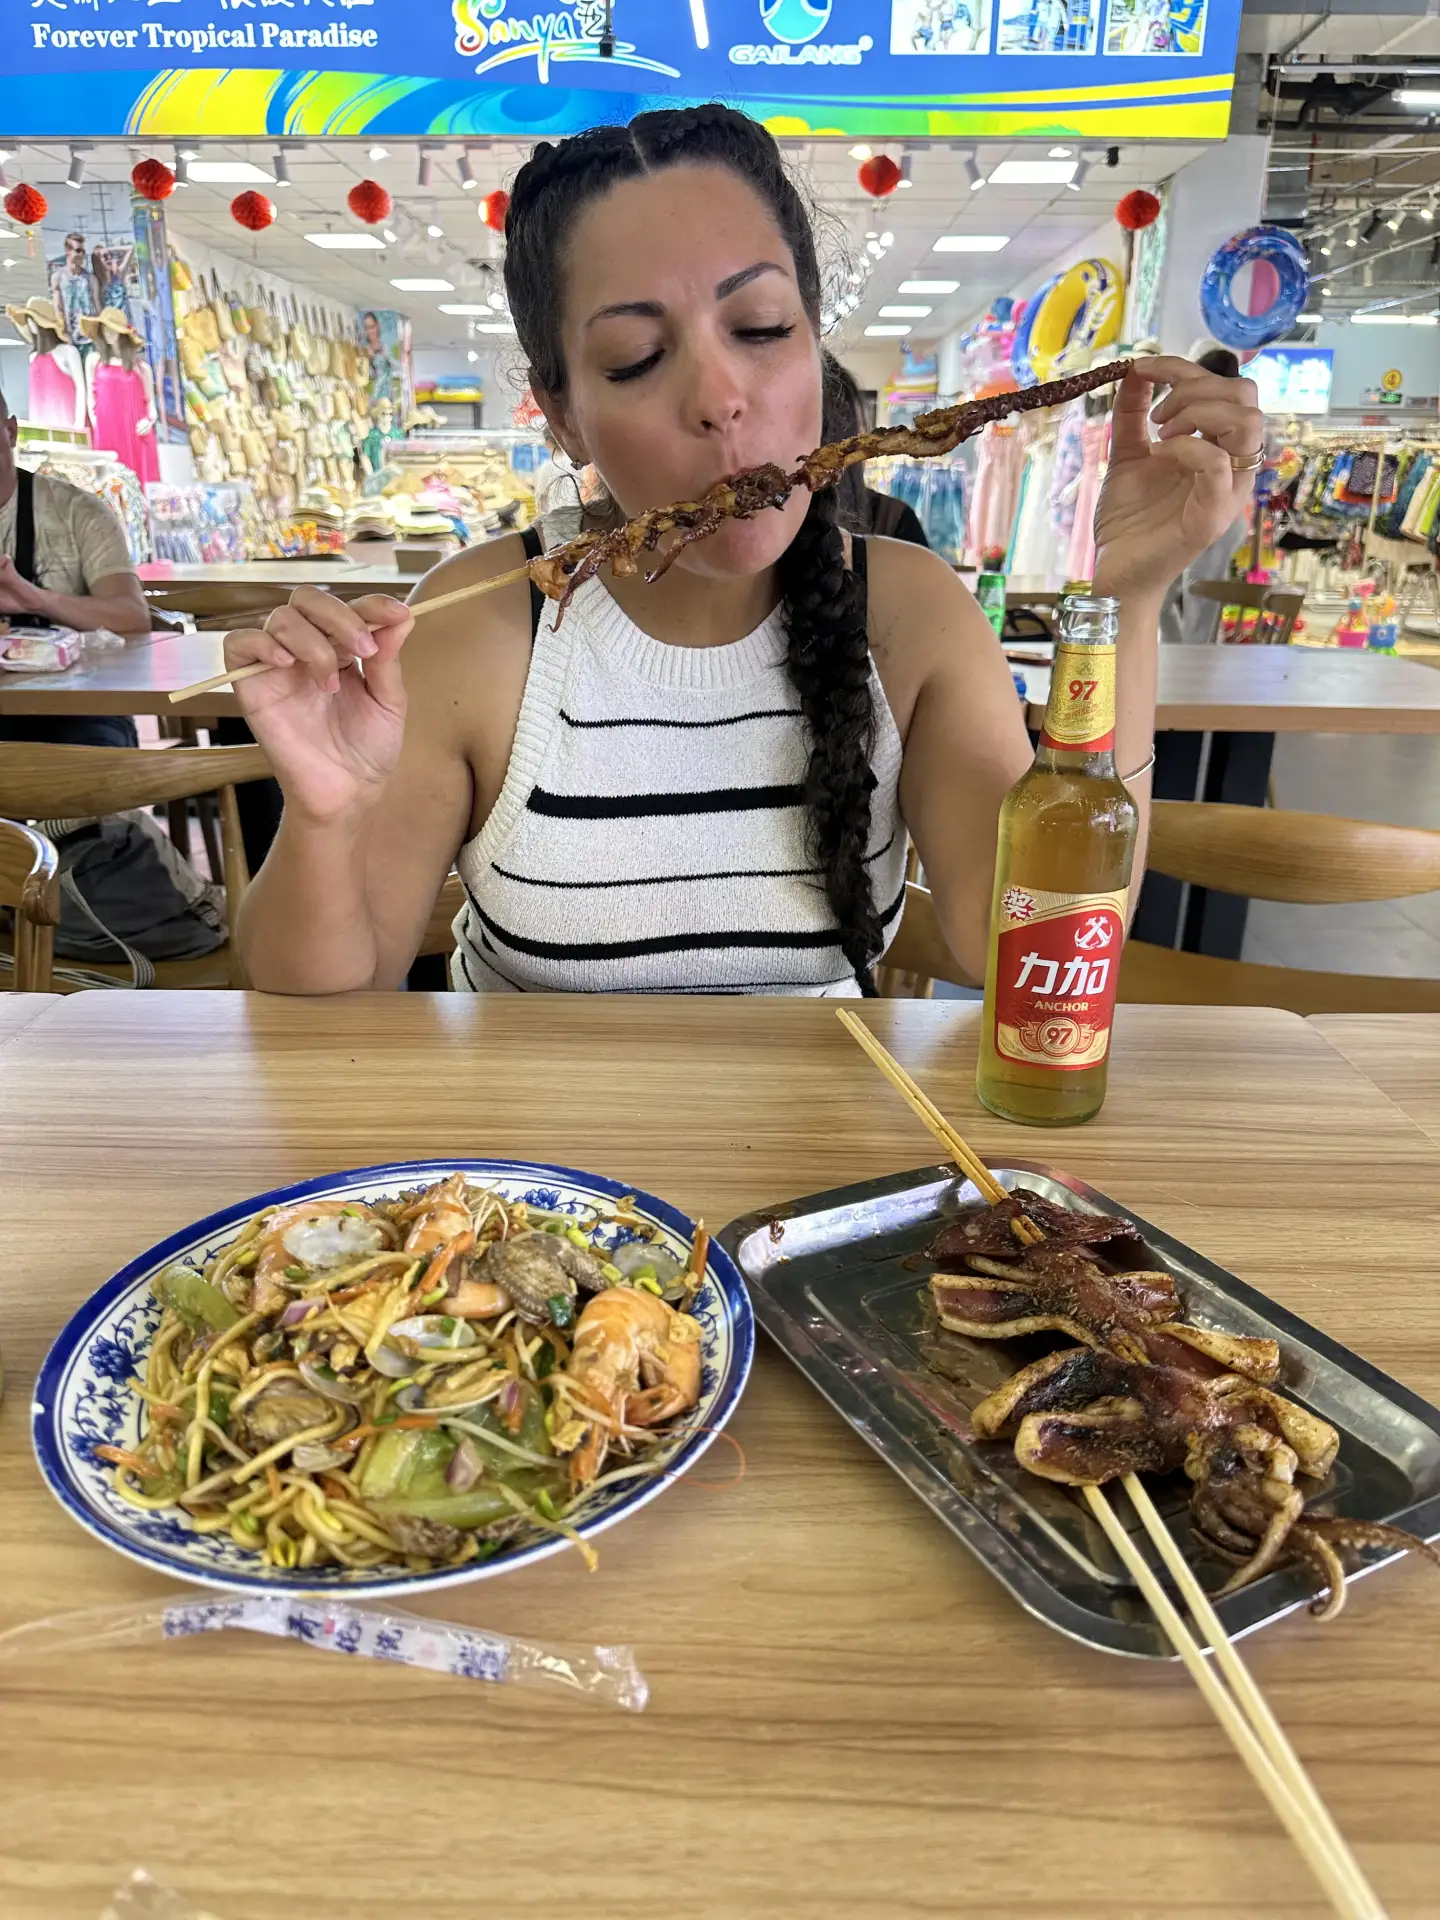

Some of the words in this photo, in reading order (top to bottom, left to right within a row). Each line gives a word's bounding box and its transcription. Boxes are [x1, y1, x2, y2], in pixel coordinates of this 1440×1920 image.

[32, 23, 138, 49] Forever
[142, 22, 256, 53] Tropical
[260, 22, 378, 48] Paradise
[1069, 680, 1098, 700] 97
[1013, 952, 1110, 996] 力加
[1034, 1000, 1089, 1012] ANCHOR
[1046, 1027, 1074, 1046] 97
